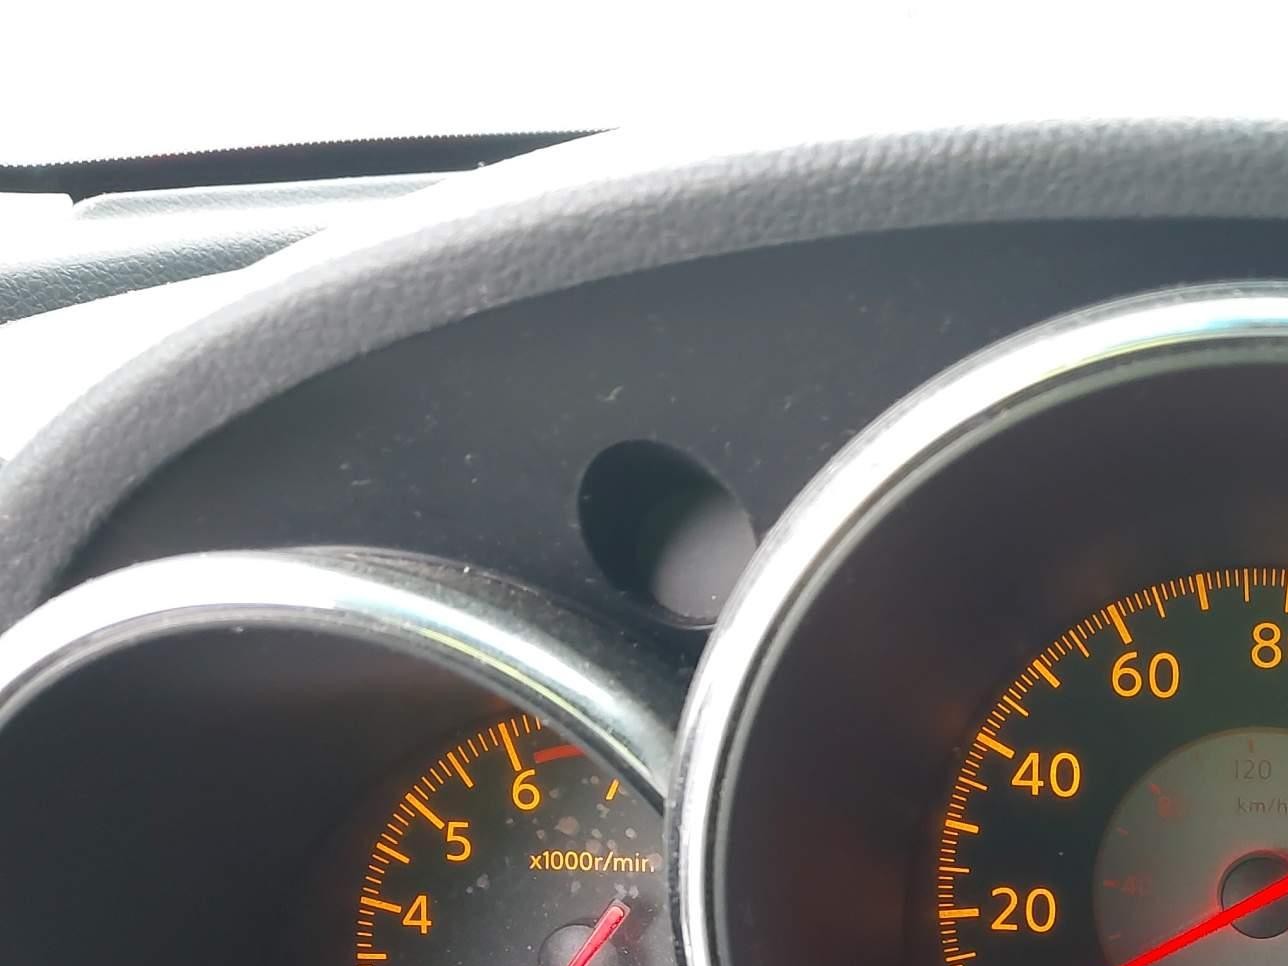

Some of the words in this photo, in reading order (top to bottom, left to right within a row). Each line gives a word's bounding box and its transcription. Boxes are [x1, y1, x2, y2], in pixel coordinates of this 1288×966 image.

[1112, 652, 1179, 697] 60
[512, 769, 541, 810] 6
[1012, 752, 1080, 796] 40
[1233, 759, 1272, 780] 120
[1236, 797, 1288, 815] km/h
[446, 822, 471, 861] 5
[402, 896, 432, 934] 4
[990, 888, 1057, 932] 20
